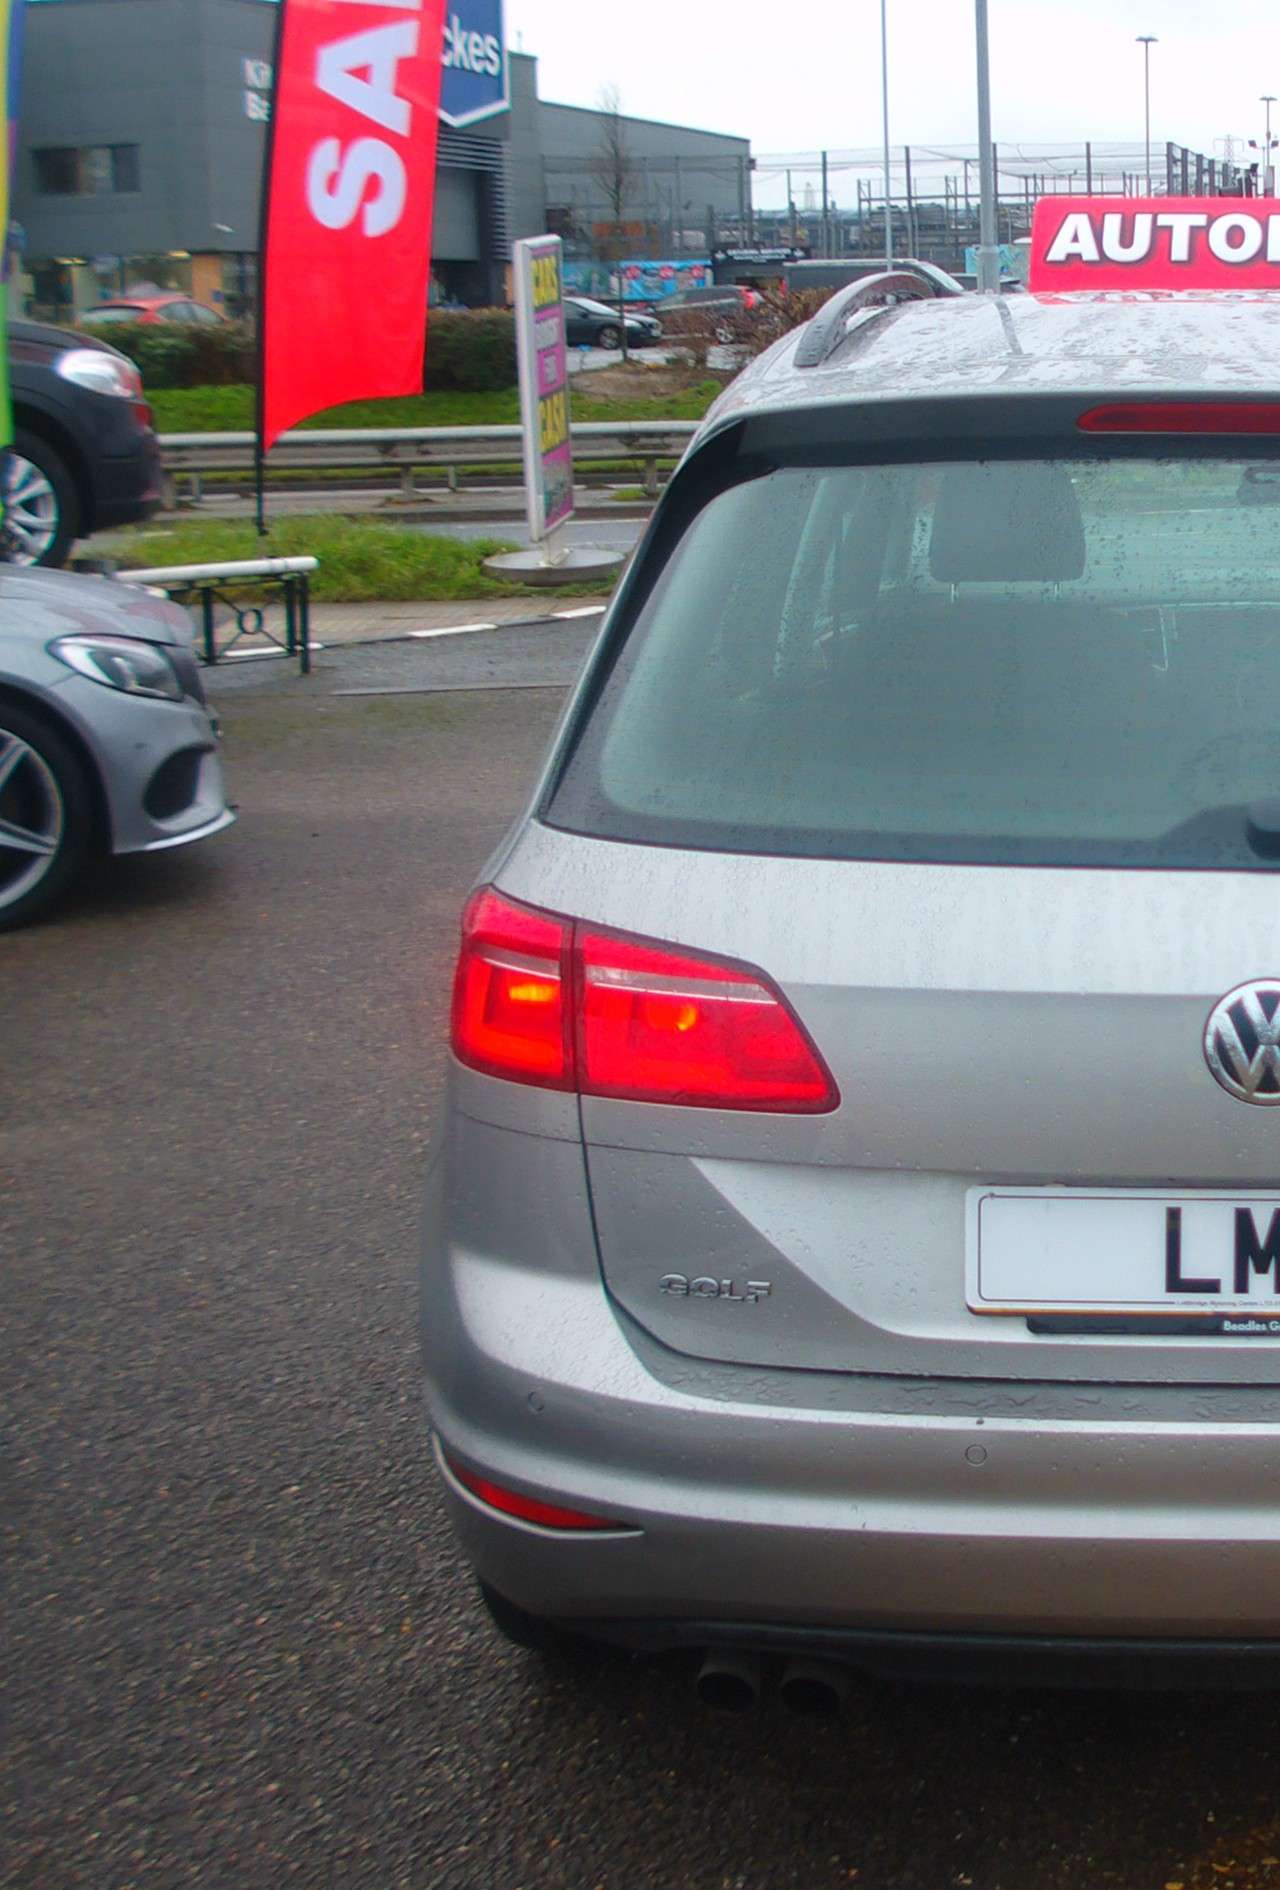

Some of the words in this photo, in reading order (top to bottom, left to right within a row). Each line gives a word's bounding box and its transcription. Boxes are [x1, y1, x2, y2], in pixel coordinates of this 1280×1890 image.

[304, 0, 422, 238] SA
[658, 1272, 773, 1304] GOLF
[1223, 1320, 1267, 1333] Beadles
